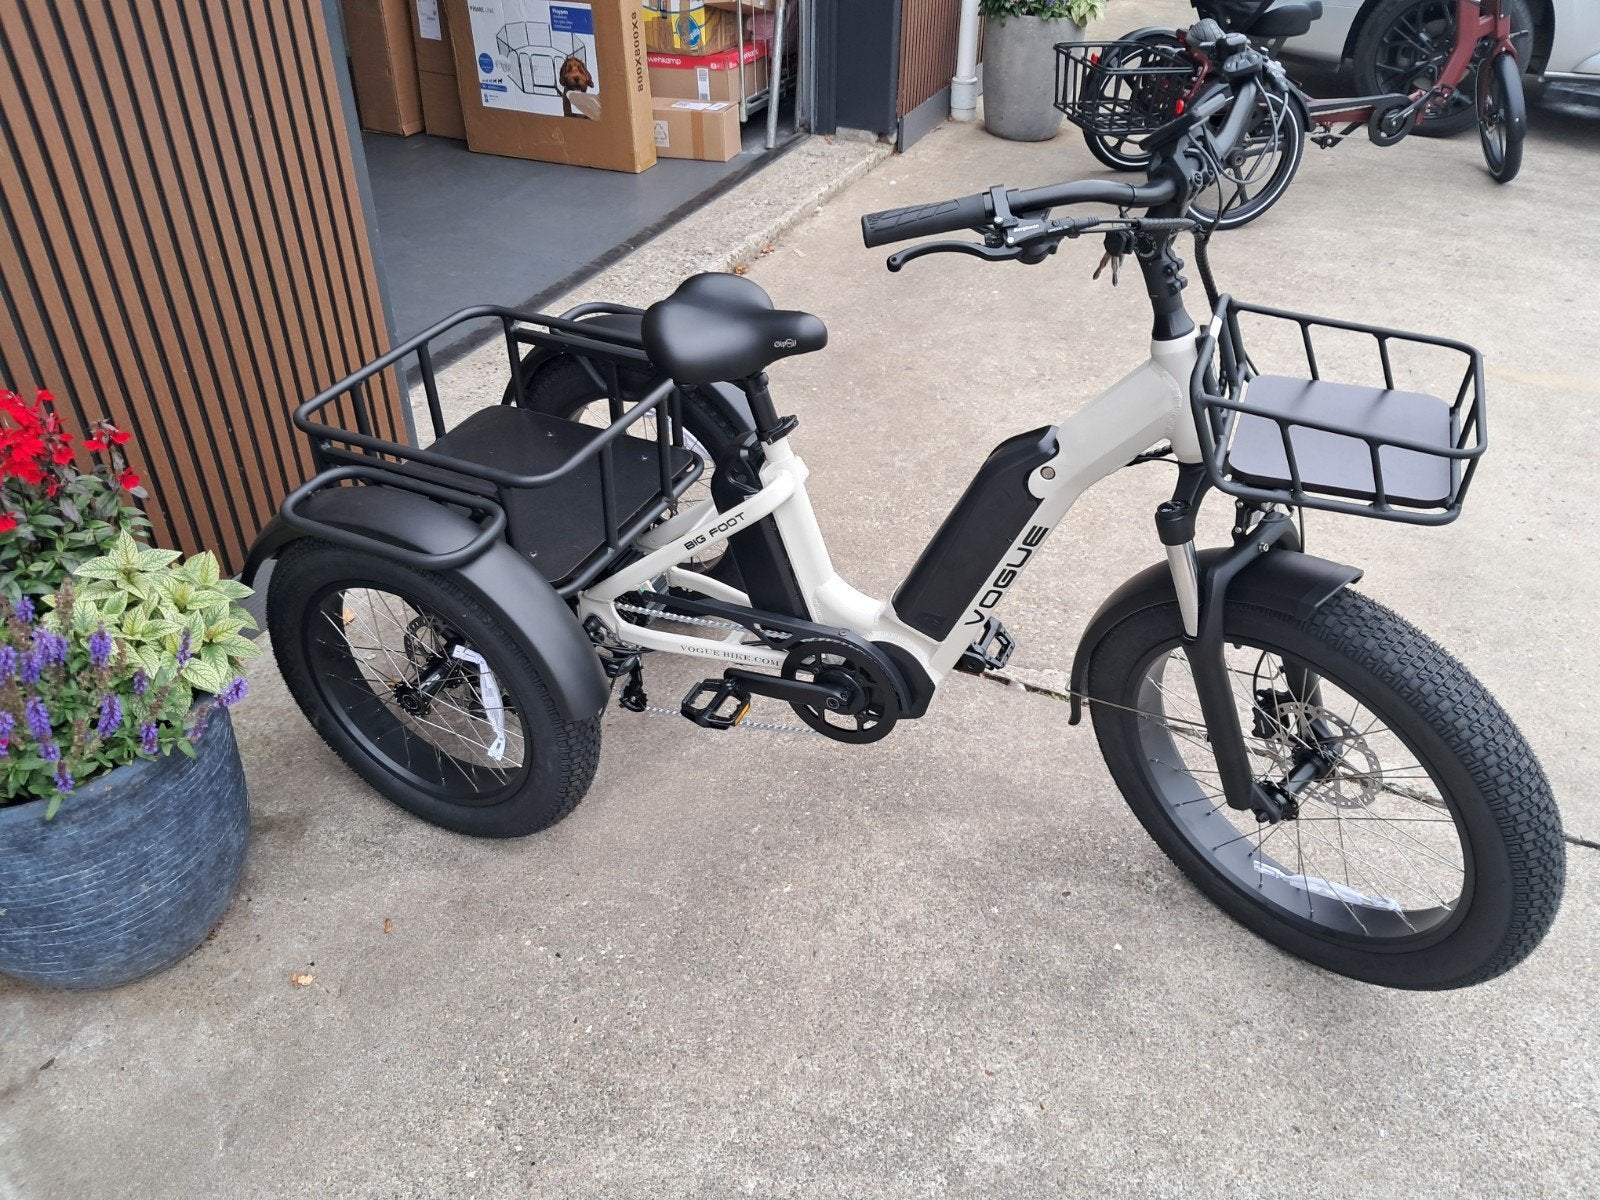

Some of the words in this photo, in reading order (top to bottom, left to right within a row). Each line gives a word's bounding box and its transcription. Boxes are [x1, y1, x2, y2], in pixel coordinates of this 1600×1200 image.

[684, 534, 707, 550] BIG
[709, 512, 745, 538] FOOT
[964, 525, 1050, 625] VOGUE
[680, 644, 720, 656] VOGUE
